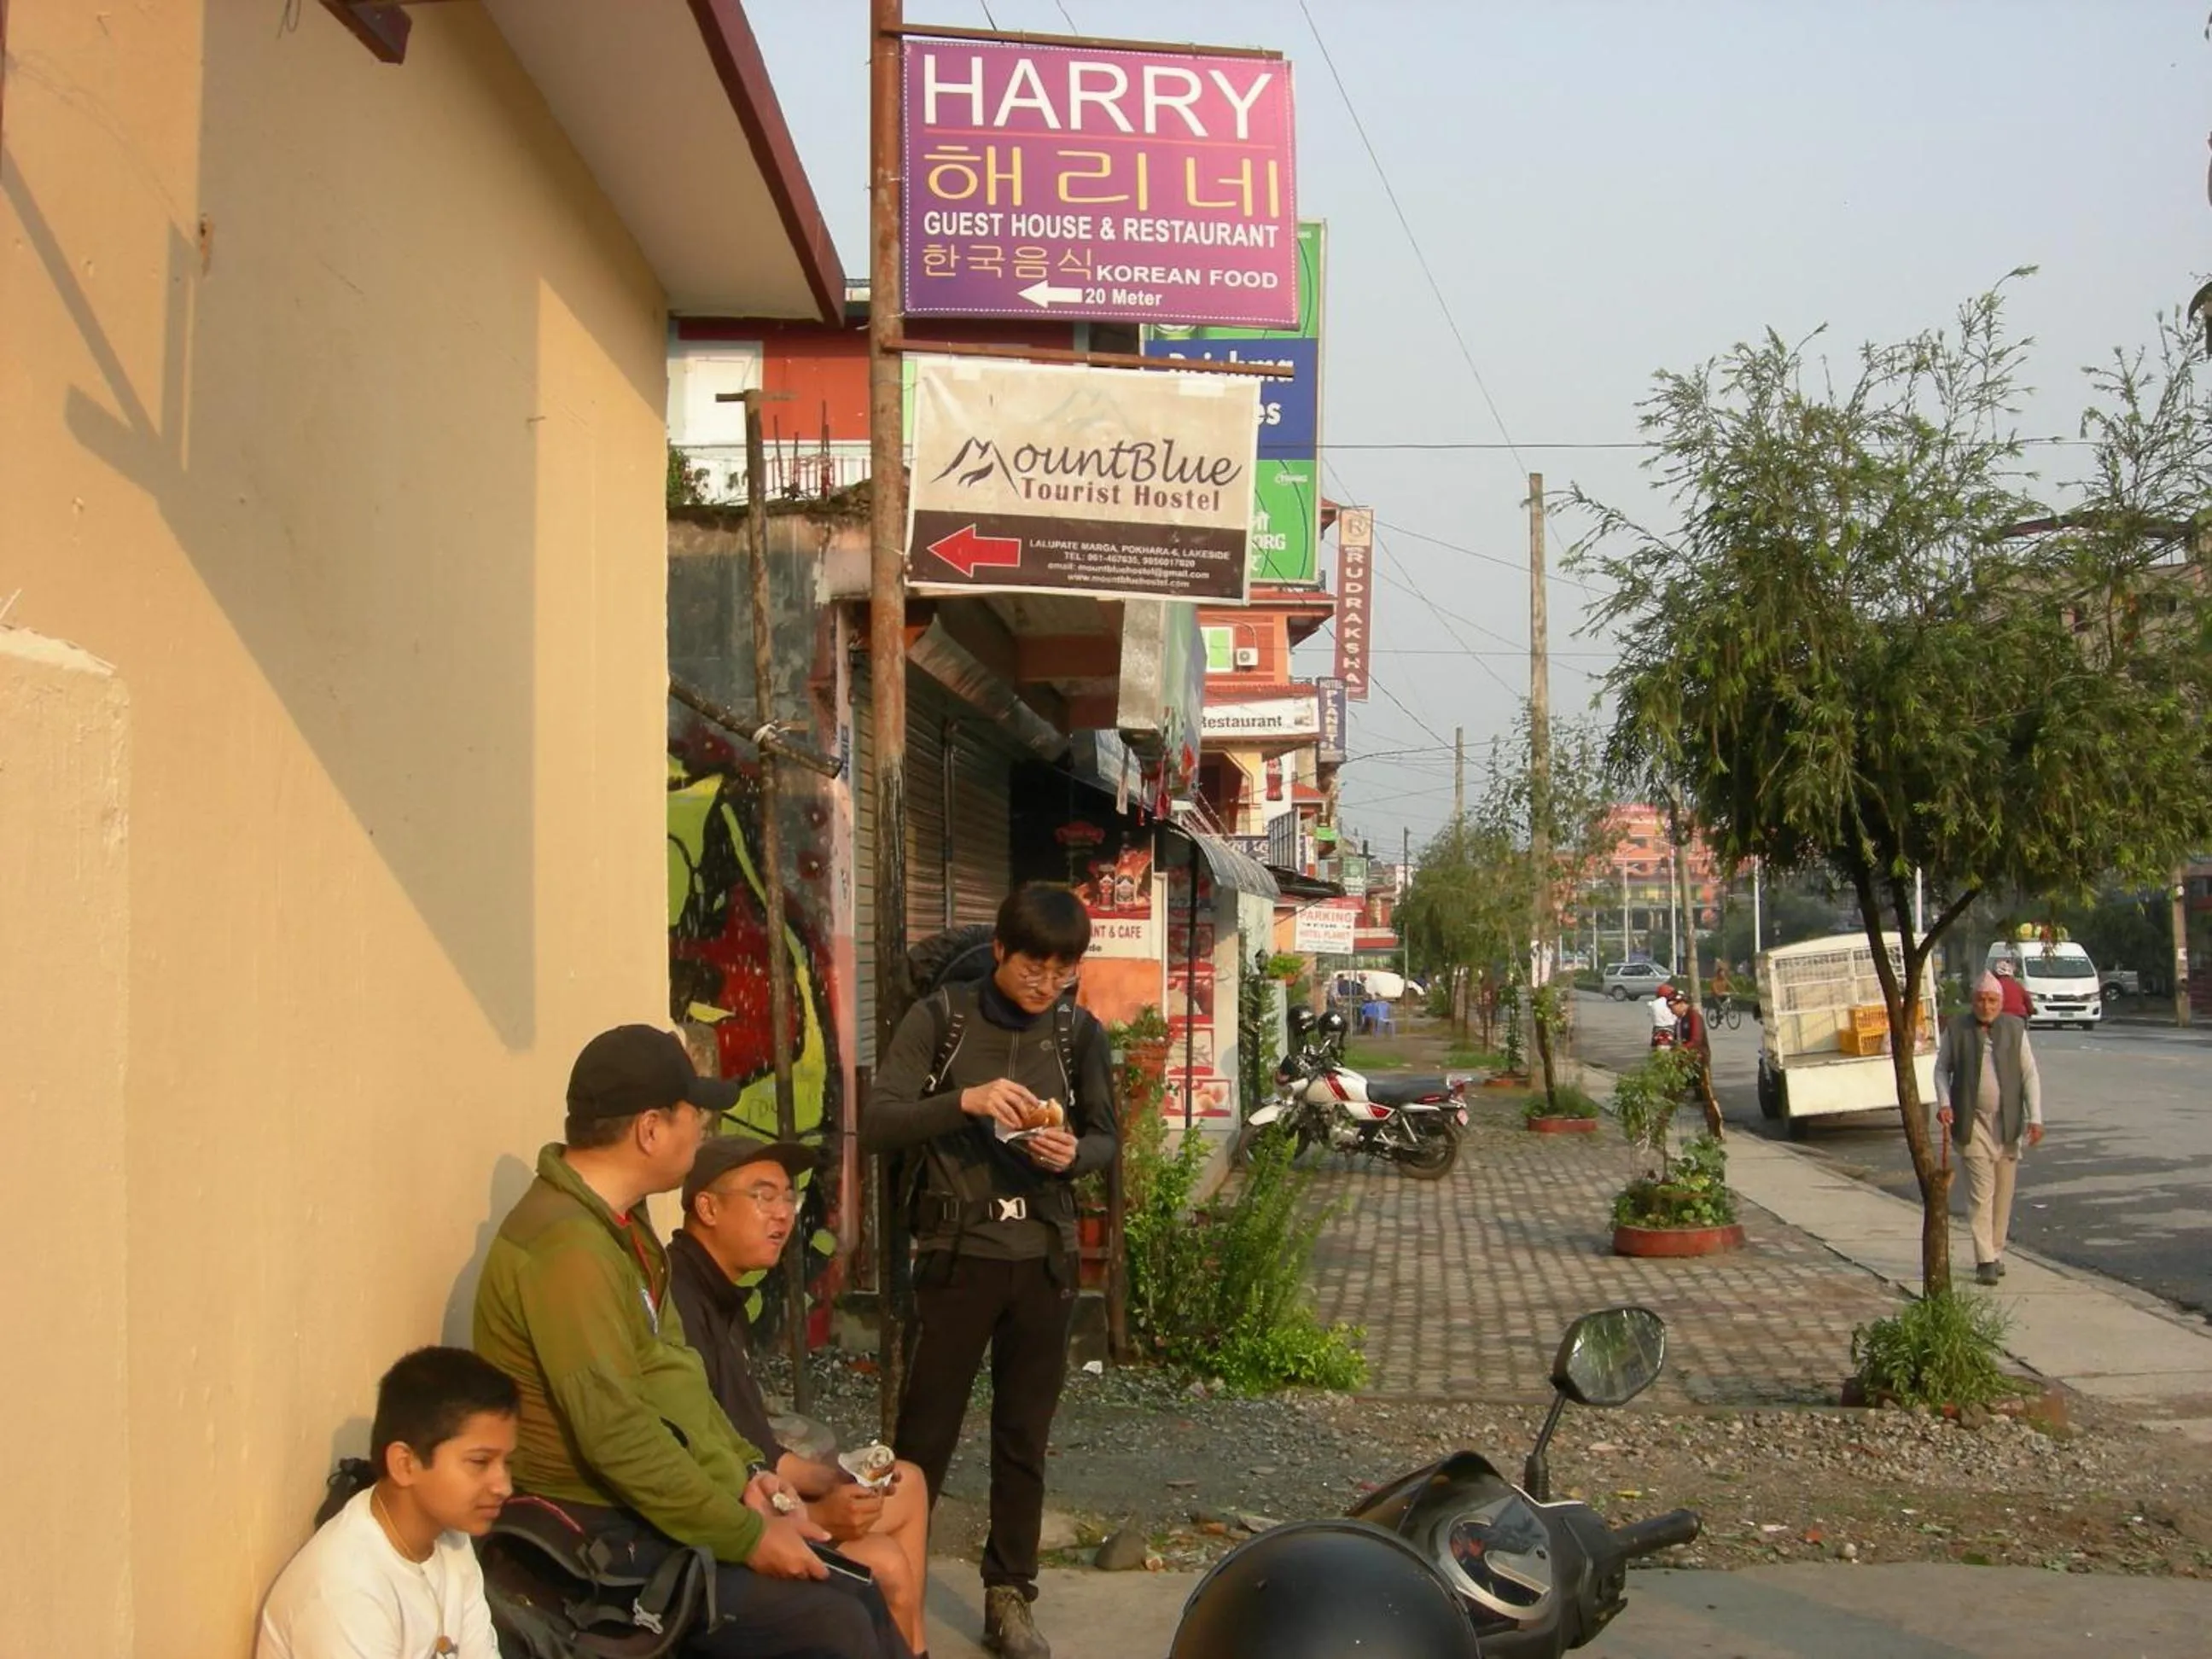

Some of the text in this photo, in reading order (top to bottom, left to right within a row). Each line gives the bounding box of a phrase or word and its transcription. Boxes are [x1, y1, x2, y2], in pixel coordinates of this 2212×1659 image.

[923, 54, 1273, 140] HARRY
[923, 145, 1279, 218] 해리네
[924, 211, 1279, 248] GUEST HOUSE & RESTAURANT
[923, 243, 1092, 282] 한국음식
[1097, 264, 1278, 288] KOREAN FOOD
[1085, 288, 1162, 307] 20 Meter
[931, 436, 1243, 497] MountBlue
[1021, 477, 1220, 512] Tourist Hostel
[1182, 549, 1231, 561] LAKESIDE
[1342, 551, 1365, 684] RUDRAKSHA
[1118, 925, 1142, 939] CAFE
